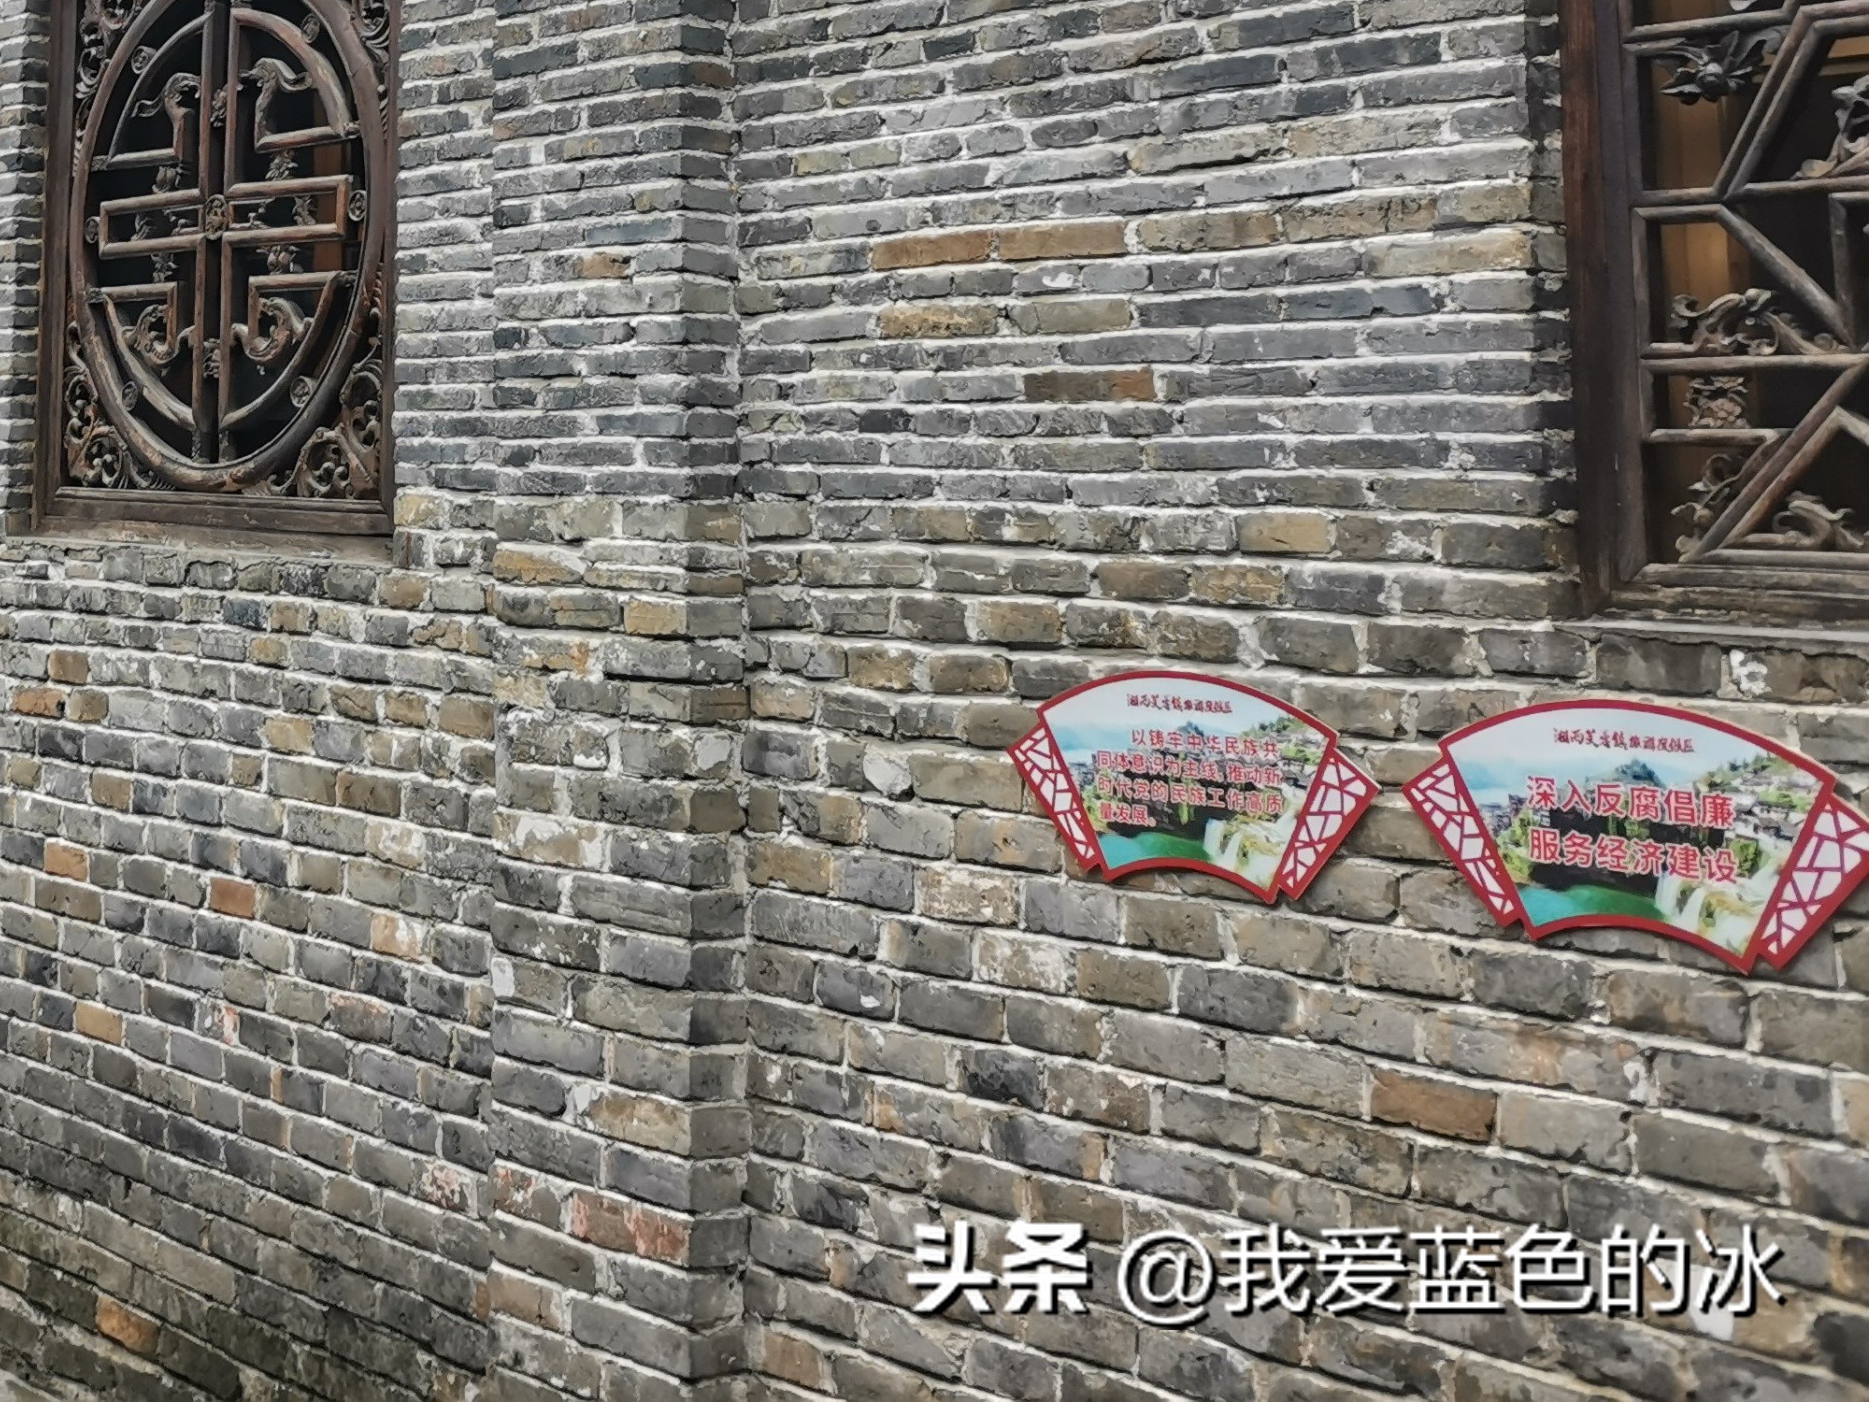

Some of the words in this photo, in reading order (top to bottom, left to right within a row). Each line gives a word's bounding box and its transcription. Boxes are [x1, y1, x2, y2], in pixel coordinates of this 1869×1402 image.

[1131, 728, 1280, 759] 以铸牢中华民族共
[1097, 776, 1284, 814] 时代党的民族工作高质
[1527, 775, 1737, 827] 深入反腐倡廉
[1529, 828, 1739, 884] 服务经济建设
